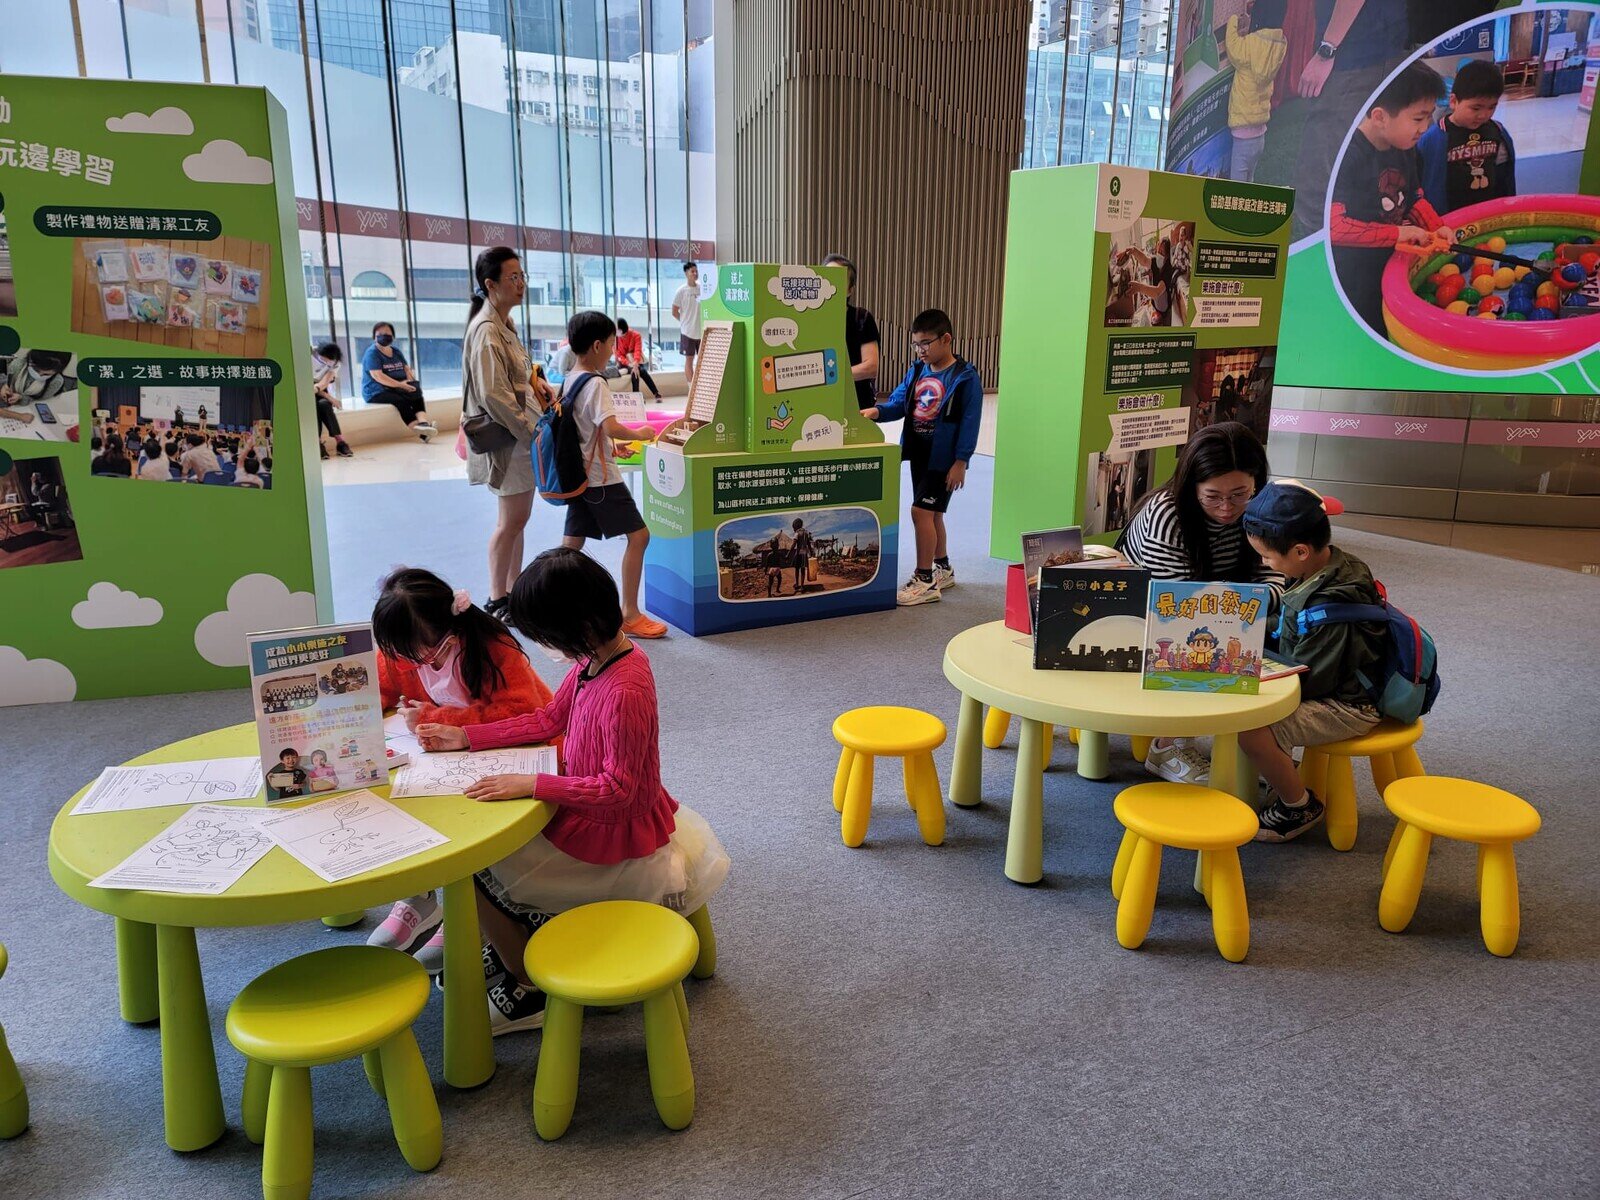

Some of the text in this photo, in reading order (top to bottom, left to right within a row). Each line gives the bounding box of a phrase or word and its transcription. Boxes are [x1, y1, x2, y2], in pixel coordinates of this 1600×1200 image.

[1210, 195, 1287, 216] 協助基層家庭改善生活環境
[46, 213, 210, 233] 製作禮物送贈清潔工友
[179, 363, 273, 380] 故事抉擇遊戲
[1156, 590, 1260, 625] 最好的發明
[264, 635, 348, 658] 成為小小樂施之友
